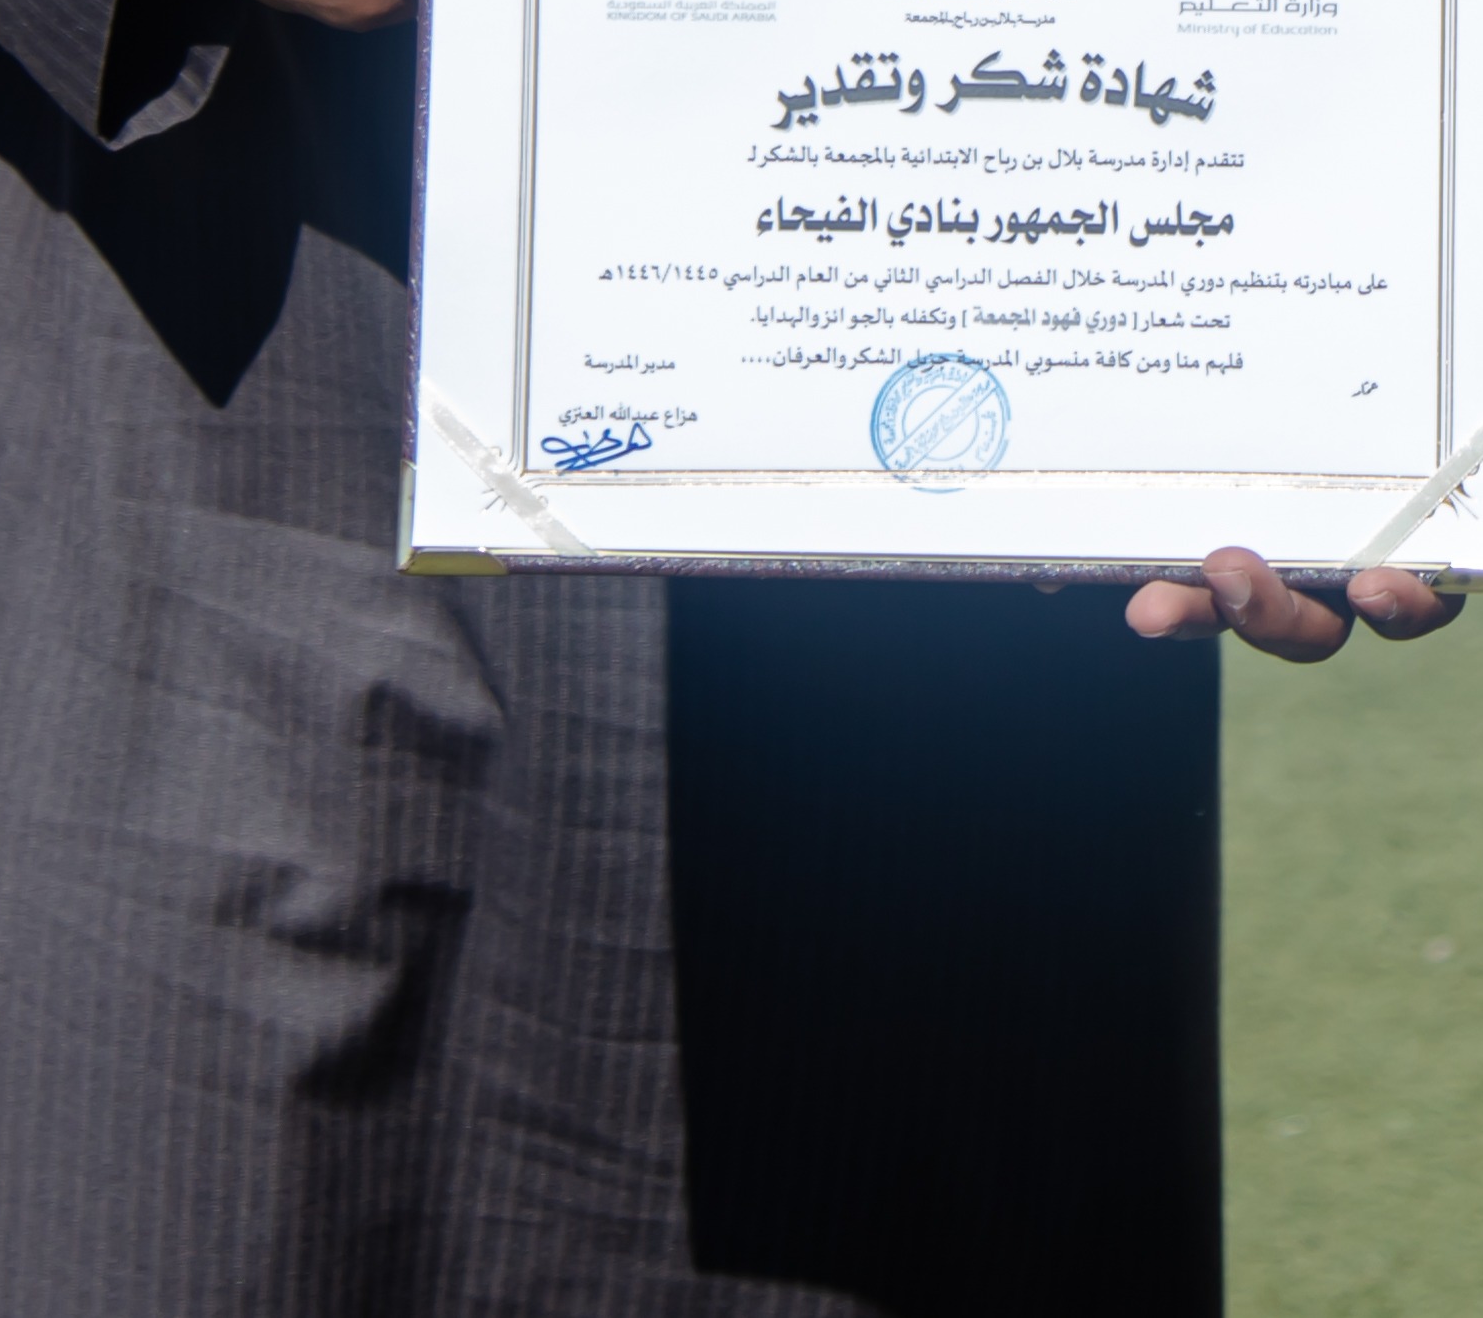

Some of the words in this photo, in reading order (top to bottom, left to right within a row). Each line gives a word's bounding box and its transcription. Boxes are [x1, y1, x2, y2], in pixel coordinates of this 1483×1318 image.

[606, 12, 667, 22] KINGDOM
[670, 13, 687, 22] OF
[691, 13, 729, 22] SAUDI
[731, 13, 777, 23] ARABIA
[1177, 23, 1240, 38] Ministry
[1242, 23, 1257, 35] of
[1261, 23, 1338, 36] Education
[769, 50, 928, 131] وتقدير
[935, 48, 1070, 113] شكر
[1079, 50, 1216, 126] شهادة
[824, 145, 896, 169] بالمجمعة
[983, 147, 1018, 174] رباح
[1022, 152, 1043, 171] بن
[1048, 148, 1083, 172] بلال
[1088, 149, 1146, 173] مدرسة
[1150, 150, 1191, 174] إدارة
[1194, 152, 1245, 176] تتقدم
[755, 195, 878, 244] الفيحاء
[886, 196, 980, 248] بنادي
[983, 200, 1118, 246] الجمهور
[1128, 199, 1235, 248] مجلس
[723, 265, 790, 290] الدراسي
[796, 266, 838, 290] العام
[844, 272, 869, 288] من
[874, 267, 919, 292] الثاني
[925, 268, 992, 289] الدراسي
[997, 269, 1057, 291] الفصل
[1062, 269, 1106, 289] خلال
[1111, 270, 1174, 293] المدرسة
[1179, 277, 1225, 295] دوري
[1229, 271, 1288, 295] بتنظيم
[1293, 273, 1352, 294] مبادرته
[1357, 273, 1388, 295] على
[900, 308, 956, 330] وتكفله
[973, 306, 1036, 332] المجمعة
[1040, 308, 1081, 333] فهود
[1085, 310, 1128, 334] دوري
[1190, 314, 1231, 330] تحت
[584, 355, 639, 374] المدرسة
[639, 359, 676, 375] مدير
[849, 347, 901, 370] الشكر
[907, 348, 950, 373] جزيل
[957, 349, 1019, 372] المدرسة
[1025, 356, 1090, 376] منسوبي
[1095, 350, 1133, 369] كافة
[1136, 357, 1171, 374] ومن
[1176, 352, 1200, 371] منا
[1205, 352, 1244, 376] فلهم
